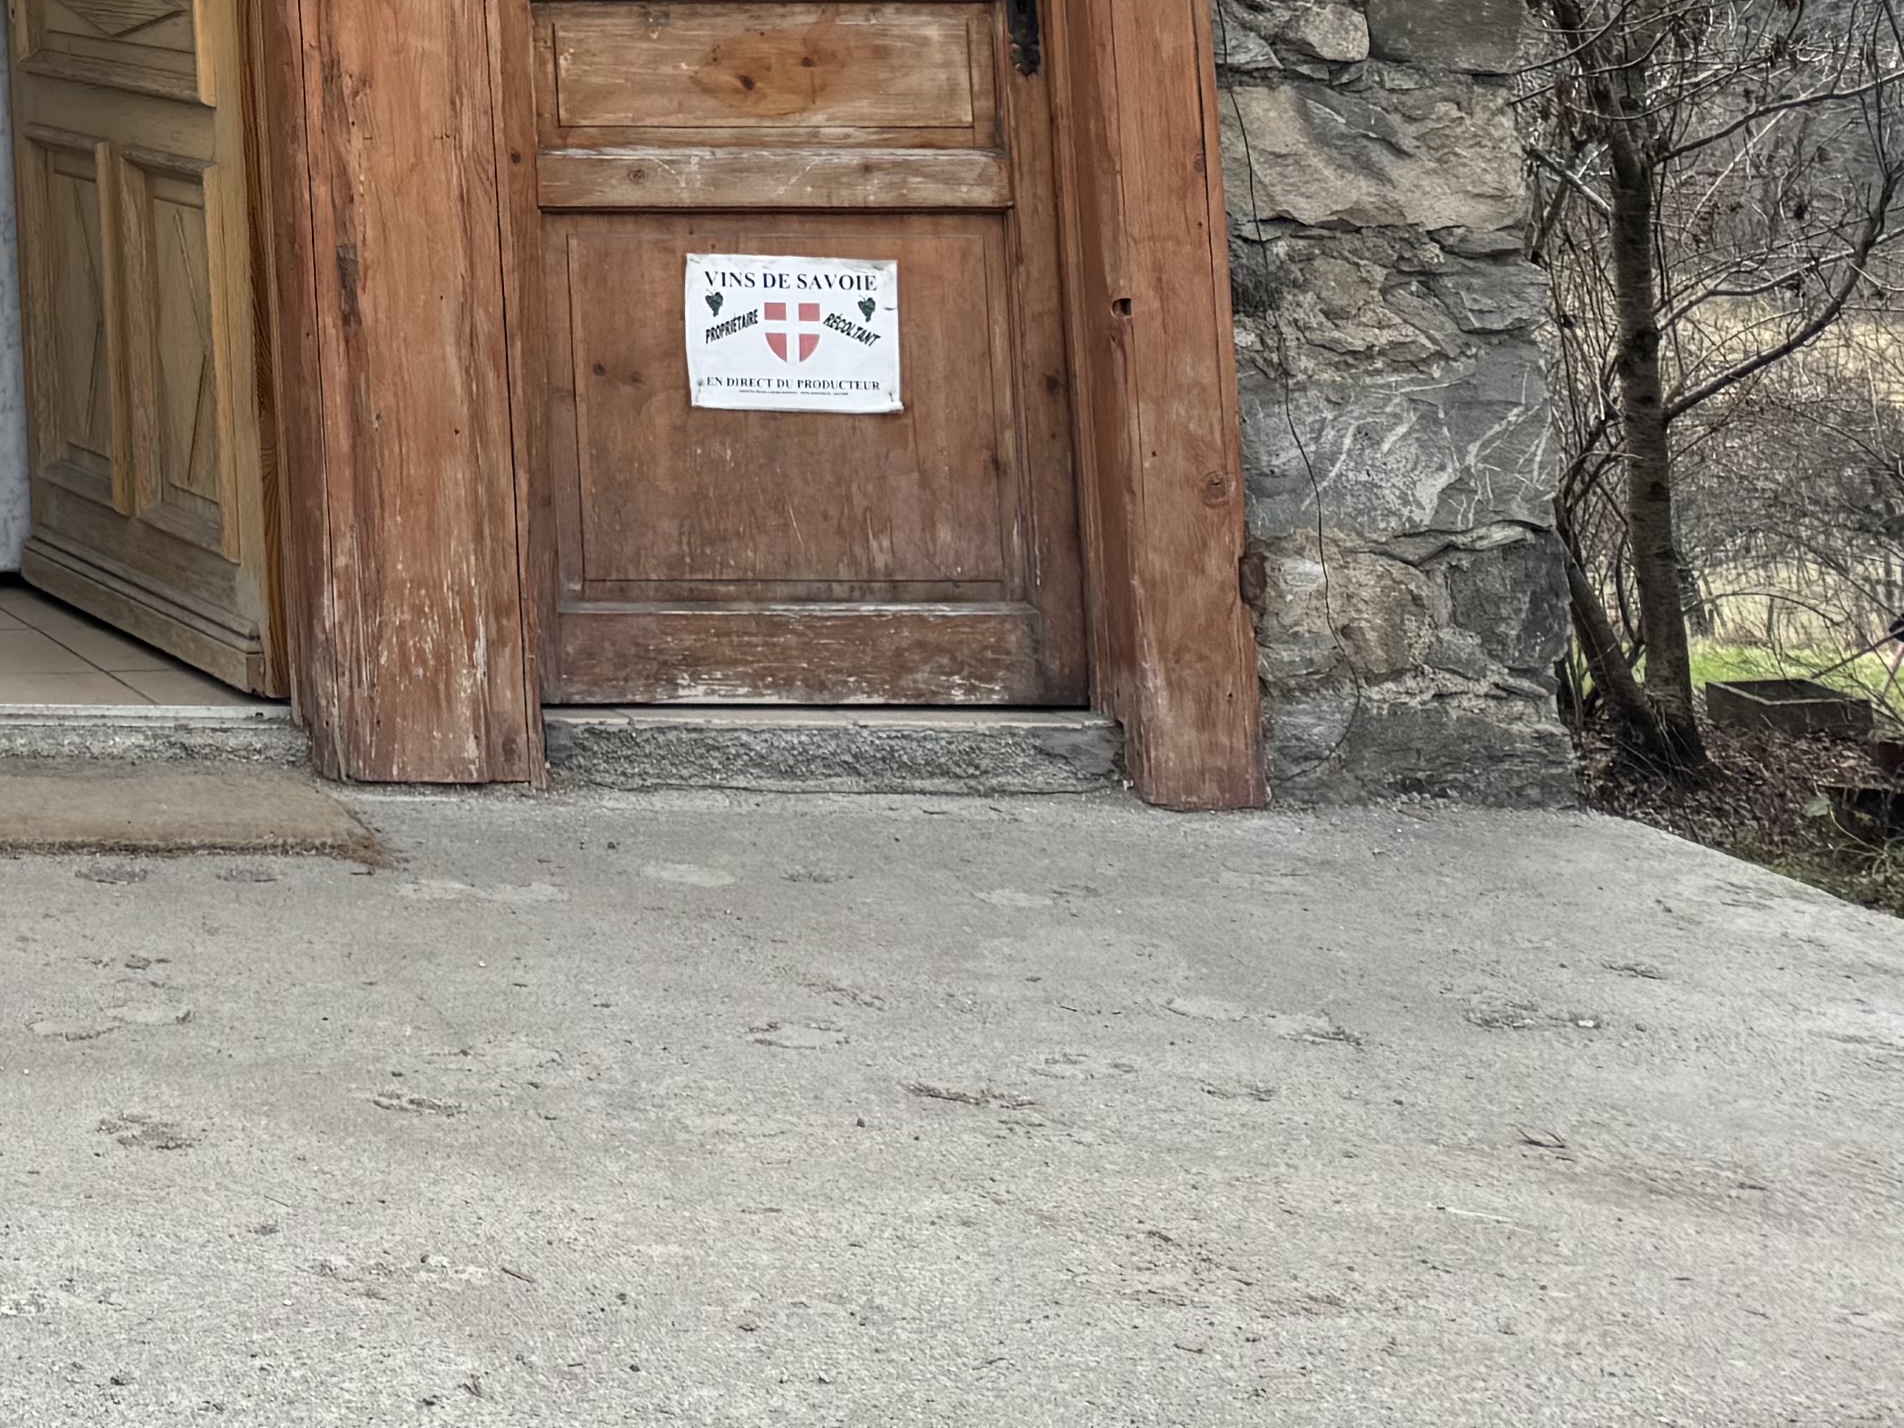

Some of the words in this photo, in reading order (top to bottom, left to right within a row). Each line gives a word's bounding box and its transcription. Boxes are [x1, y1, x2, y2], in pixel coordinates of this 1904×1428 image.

[704, 270, 756, 289] VINS
[762, 272, 791, 290] DE
[796, 273, 878, 292] SAVOIE
[822, 312, 881, 347] RÉCOLTANT
[706, 376, 723, 387] EN
[726, 376, 774, 388] DIRECT
[776, 378, 794, 389] DU
[797, 378, 880, 391] PRODUCTEUR
